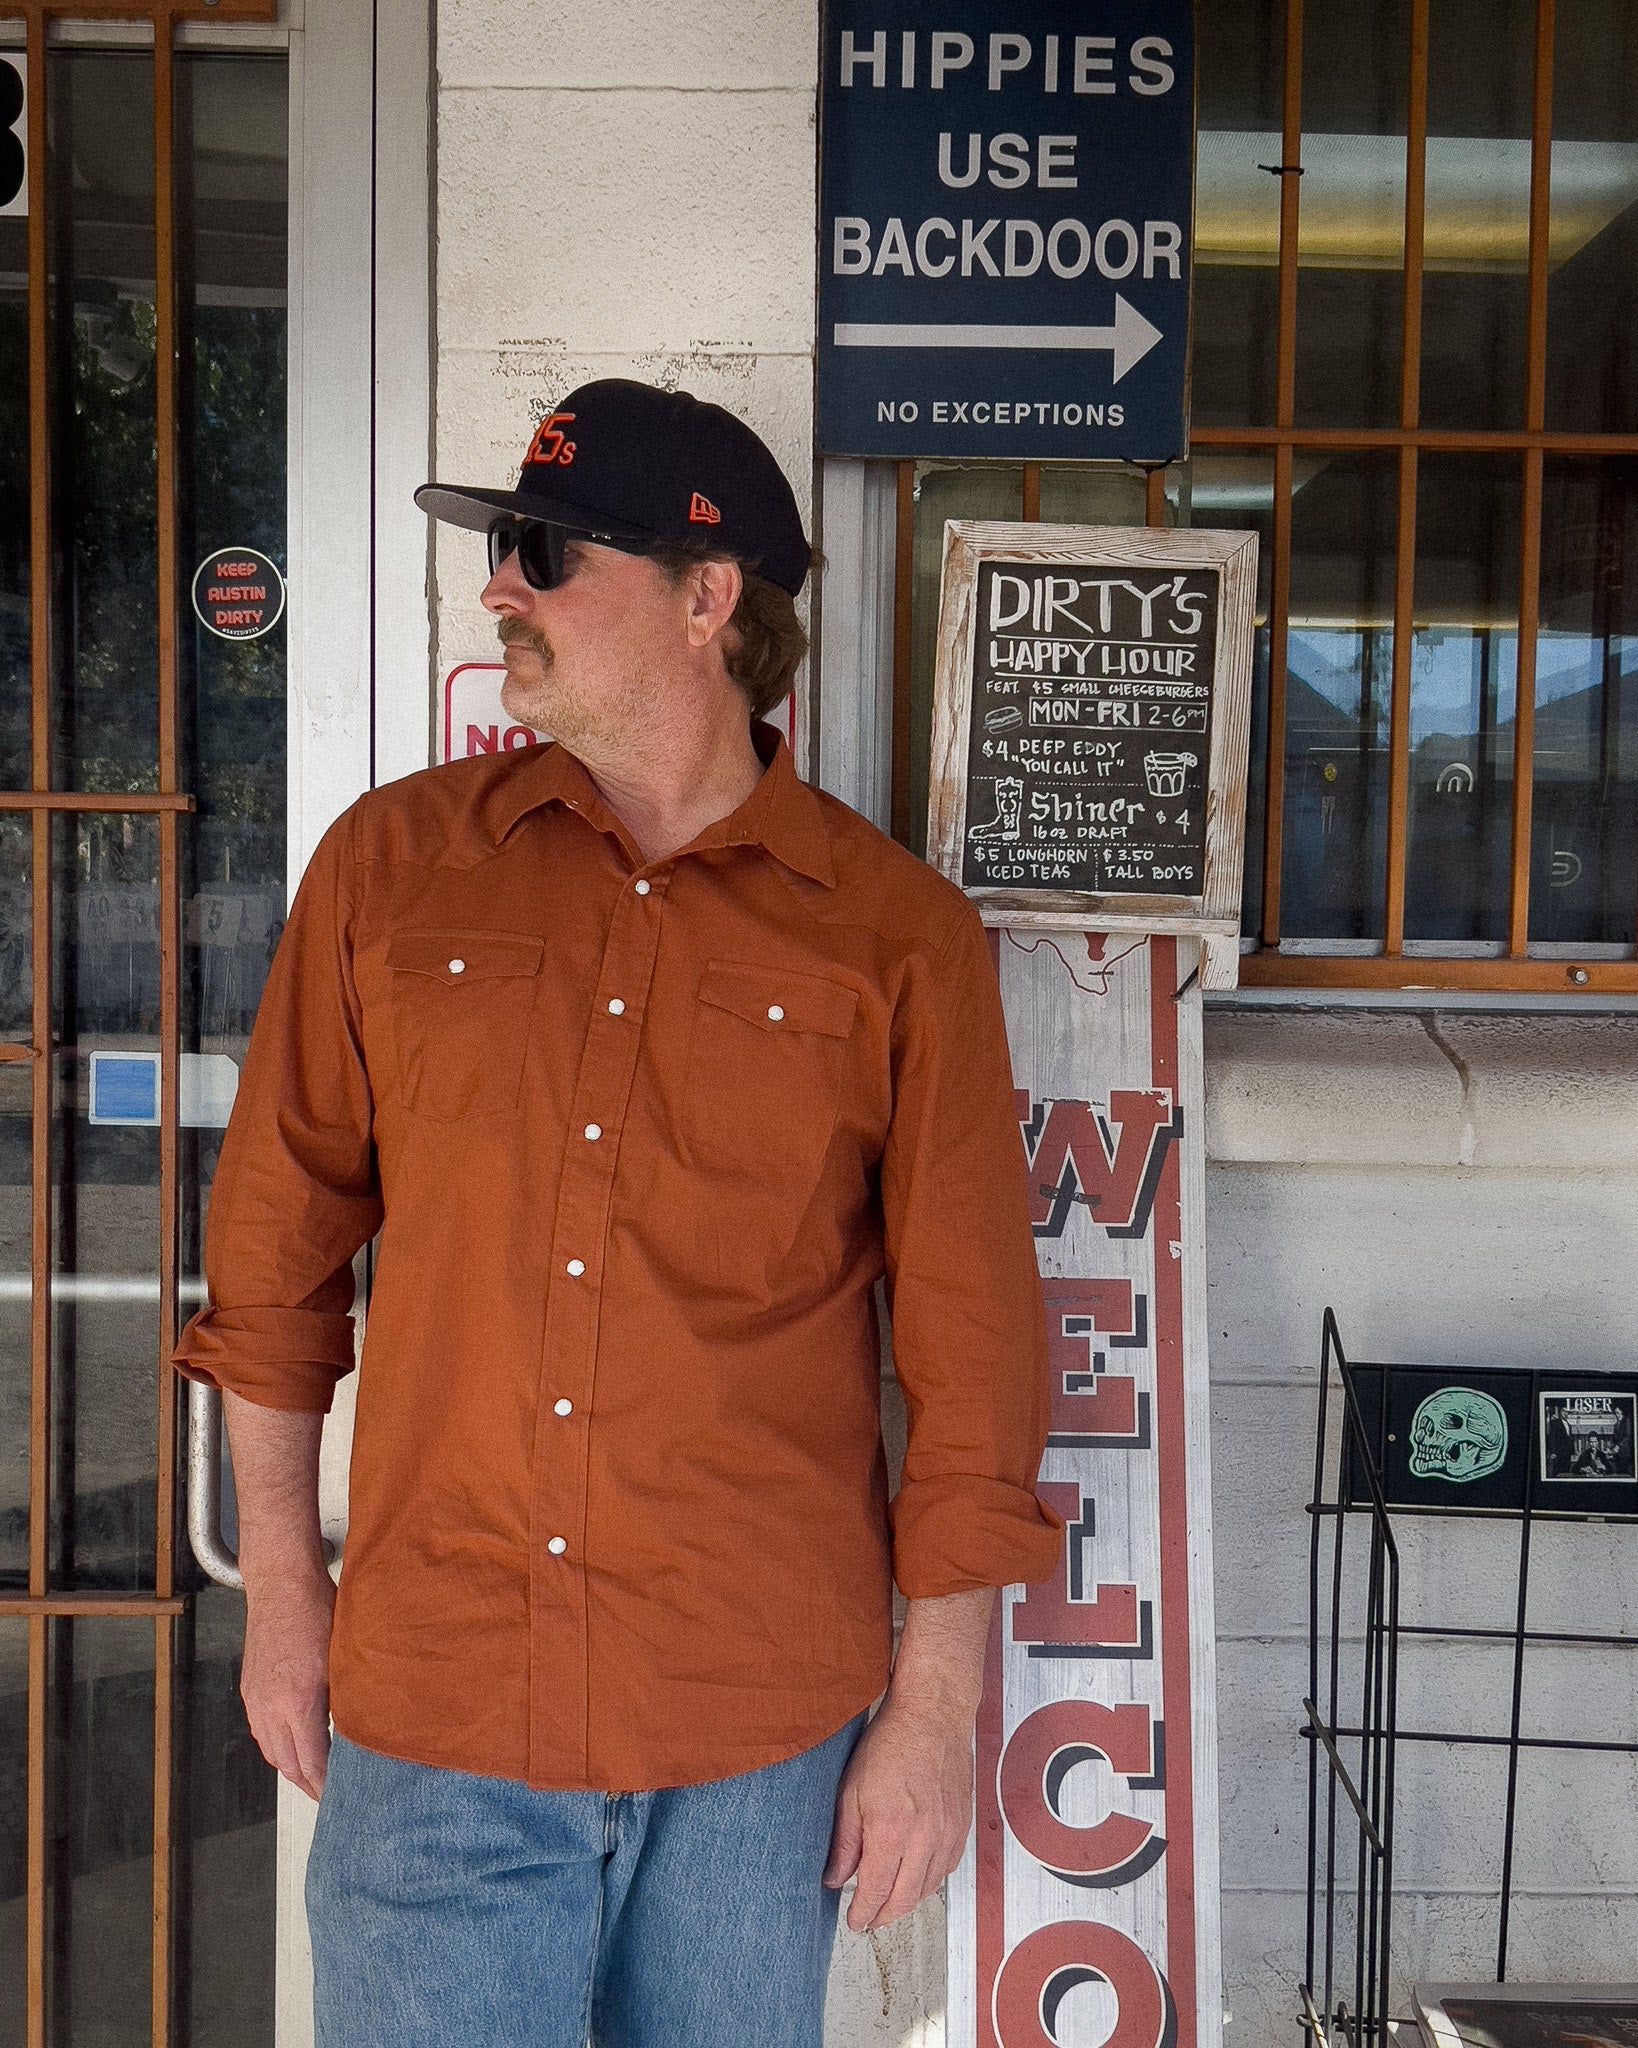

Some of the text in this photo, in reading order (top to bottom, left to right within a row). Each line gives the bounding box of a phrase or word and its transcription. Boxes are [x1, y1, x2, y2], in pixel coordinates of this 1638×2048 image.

[840, 31, 1175, 95] HIPPIES
[938, 132, 1078, 189] USE
[833, 217, 1182, 280] BACKDOOR
[877, 401, 1125, 427] NO EXCEPTIONS
[216, 563, 257, 577] KEEP
[207, 586, 266, 601] AUSTIN
[215, 610, 263, 625] DIRTY
[989, 640, 1196, 677] HAPPY HOUR
[985, 680, 1020, 694] FEAT.
[1032, 681, 1053, 696] $5
[1060, 683, 1101, 696] SMALL
[466, 724, 537, 756] NO
[981, 739, 1123, 761] $4 DEEP EDDY
[1054, 760, 1089, 775] CALL
[1027, 792, 1146, 824] Shiner
[1076, 826, 1128, 839] DRAFT
[974, 846, 1089, 863] $5 LONGHORN
[985, 864, 1071, 880] ICED TEAS
[1104, 865, 1195, 881] TALL BOYS
